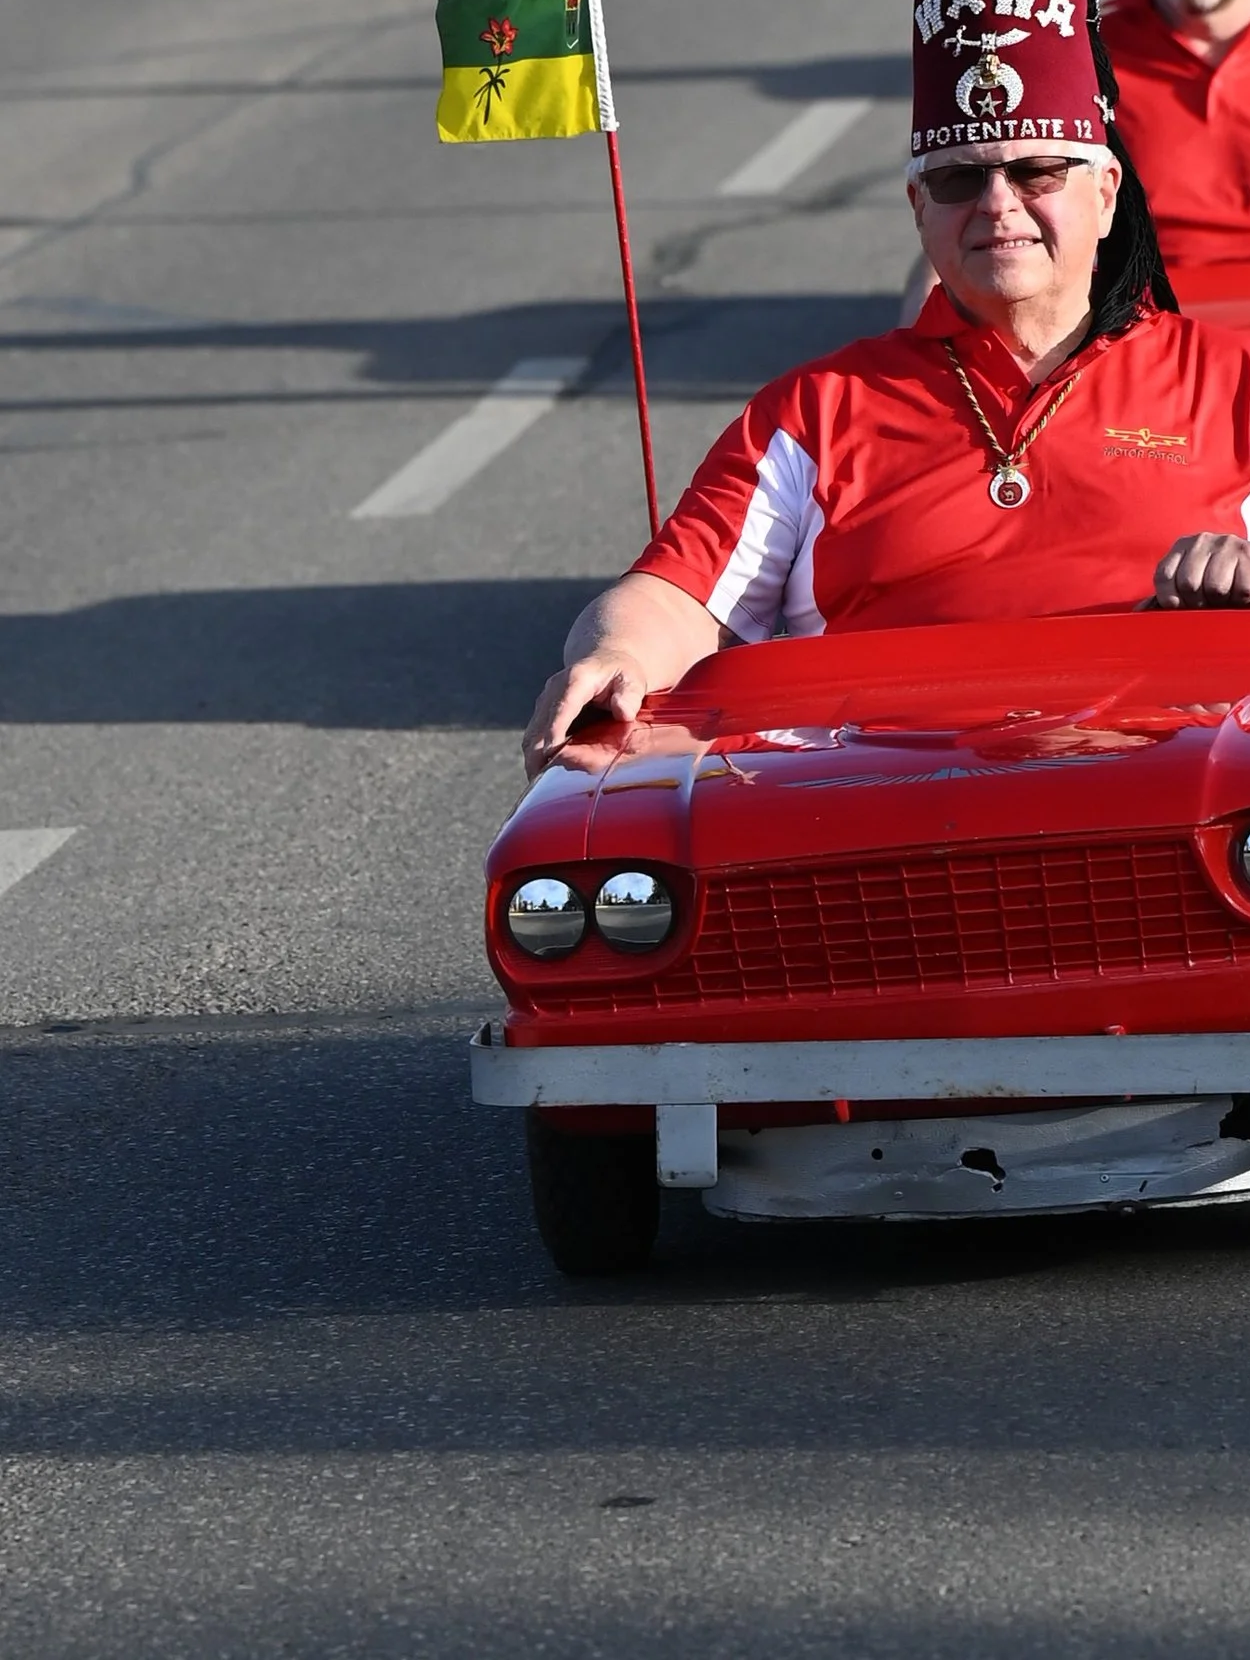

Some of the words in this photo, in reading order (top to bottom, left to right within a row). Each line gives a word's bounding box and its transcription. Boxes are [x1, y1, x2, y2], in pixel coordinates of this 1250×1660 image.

[927, 119, 1064, 146] POTENTATE
[1075, 120, 1093, 139] 12
[1104, 447, 1144, 458] MOTOR
[1148, 451, 1188, 465] PATROL
